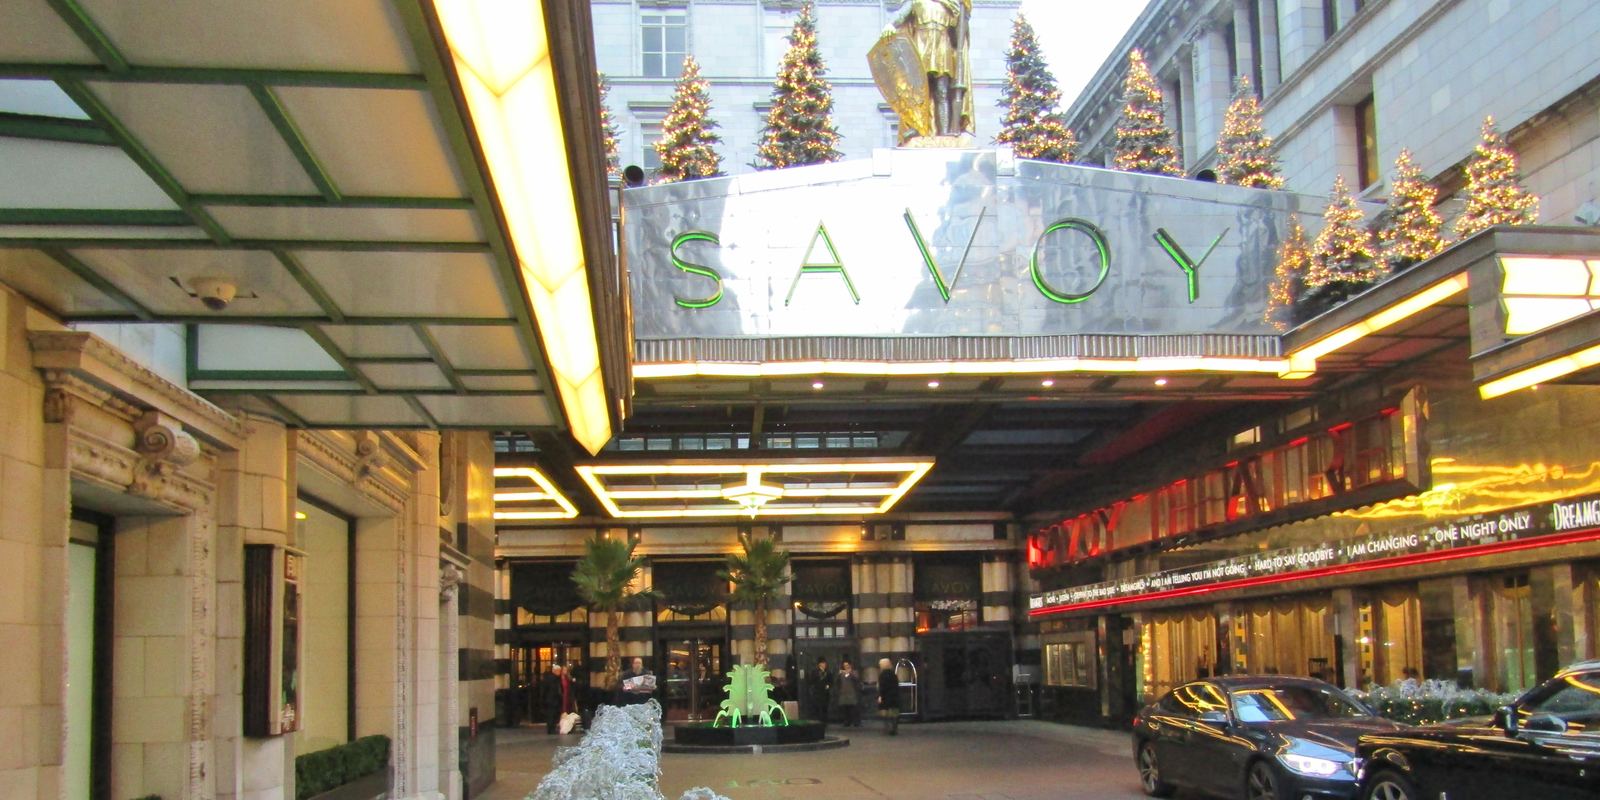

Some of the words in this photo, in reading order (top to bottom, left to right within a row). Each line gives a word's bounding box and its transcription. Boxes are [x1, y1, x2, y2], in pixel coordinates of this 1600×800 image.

[670, 206, 1231, 309] SAVOY
[1027, 499, 1128, 569] SAVOY
[1191, 571, 1202, 581] YOU
[1212, 567, 1224, 577] NOT
[1225, 564, 1245, 576] GOING
[1255, 558, 1272, 570] HARD
[1272, 557, 1283, 568] TO
[1284, 555, 1296, 567] SAY
[1297, 548, 1334, 564] GOODBYE
[1351, 544, 1366, 556] AM
[1367, 534, 1418, 554] CHANGING
[1435, 526, 1459, 543] ONE
[1460, 520, 1496, 539] NIGHT
[1498, 514, 1530, 533] ONLY
